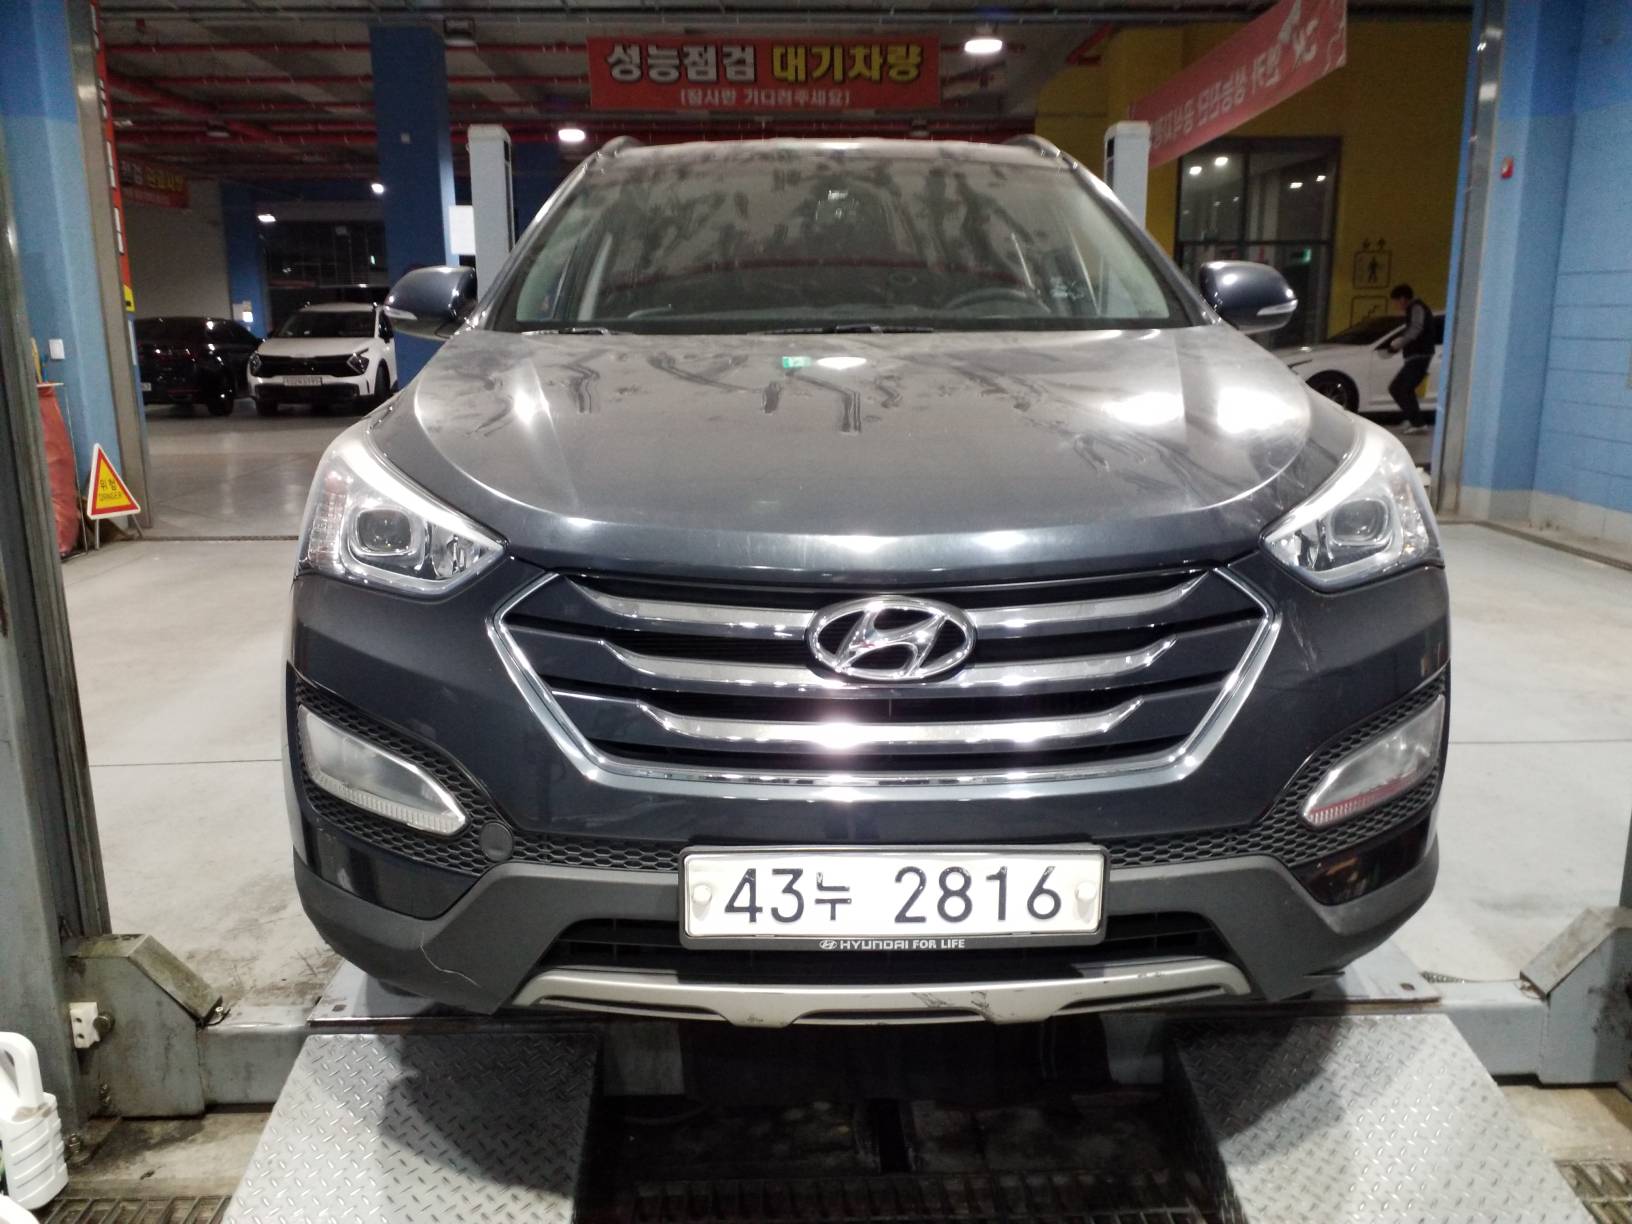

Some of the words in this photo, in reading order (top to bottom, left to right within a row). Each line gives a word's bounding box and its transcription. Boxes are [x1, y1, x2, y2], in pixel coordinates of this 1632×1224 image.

[607, 45, 756, 82] 성능점검
[772, 44, 922, 82] 대기차량
[724, 867, 853, 923] 43누
[893, 865, 1063, 923] 2816
[840, 939, 909, 950] HYUNDAI
[912, 939, 938, 949] FOR
[940, 938, 966, 949] LIFE
